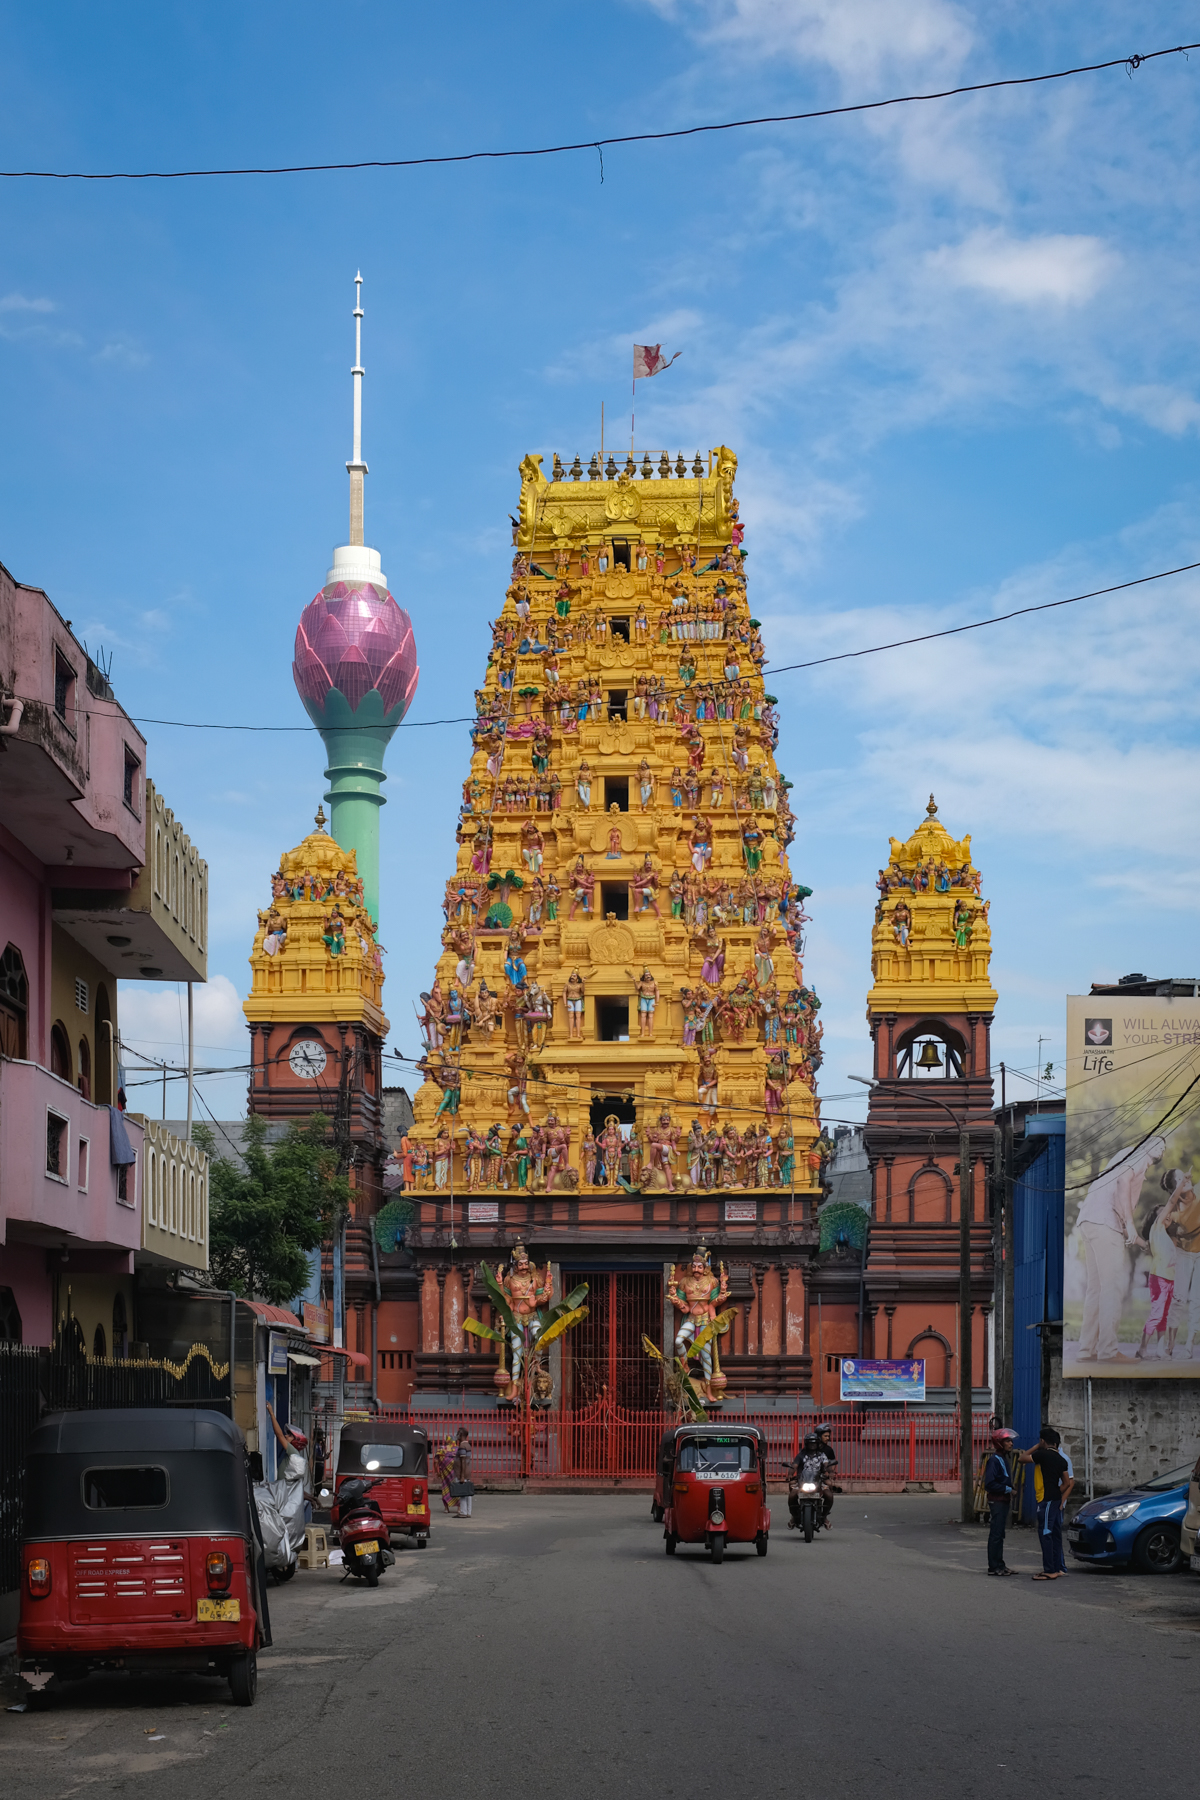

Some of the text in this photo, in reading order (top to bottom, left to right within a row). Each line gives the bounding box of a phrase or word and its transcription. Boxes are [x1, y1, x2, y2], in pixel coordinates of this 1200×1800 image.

[1123, 1018, 1158, 1030] WILL
[1123, 1034, 1159, 1044] YOUR
[1083, 1056, 1113, 1074] Life
